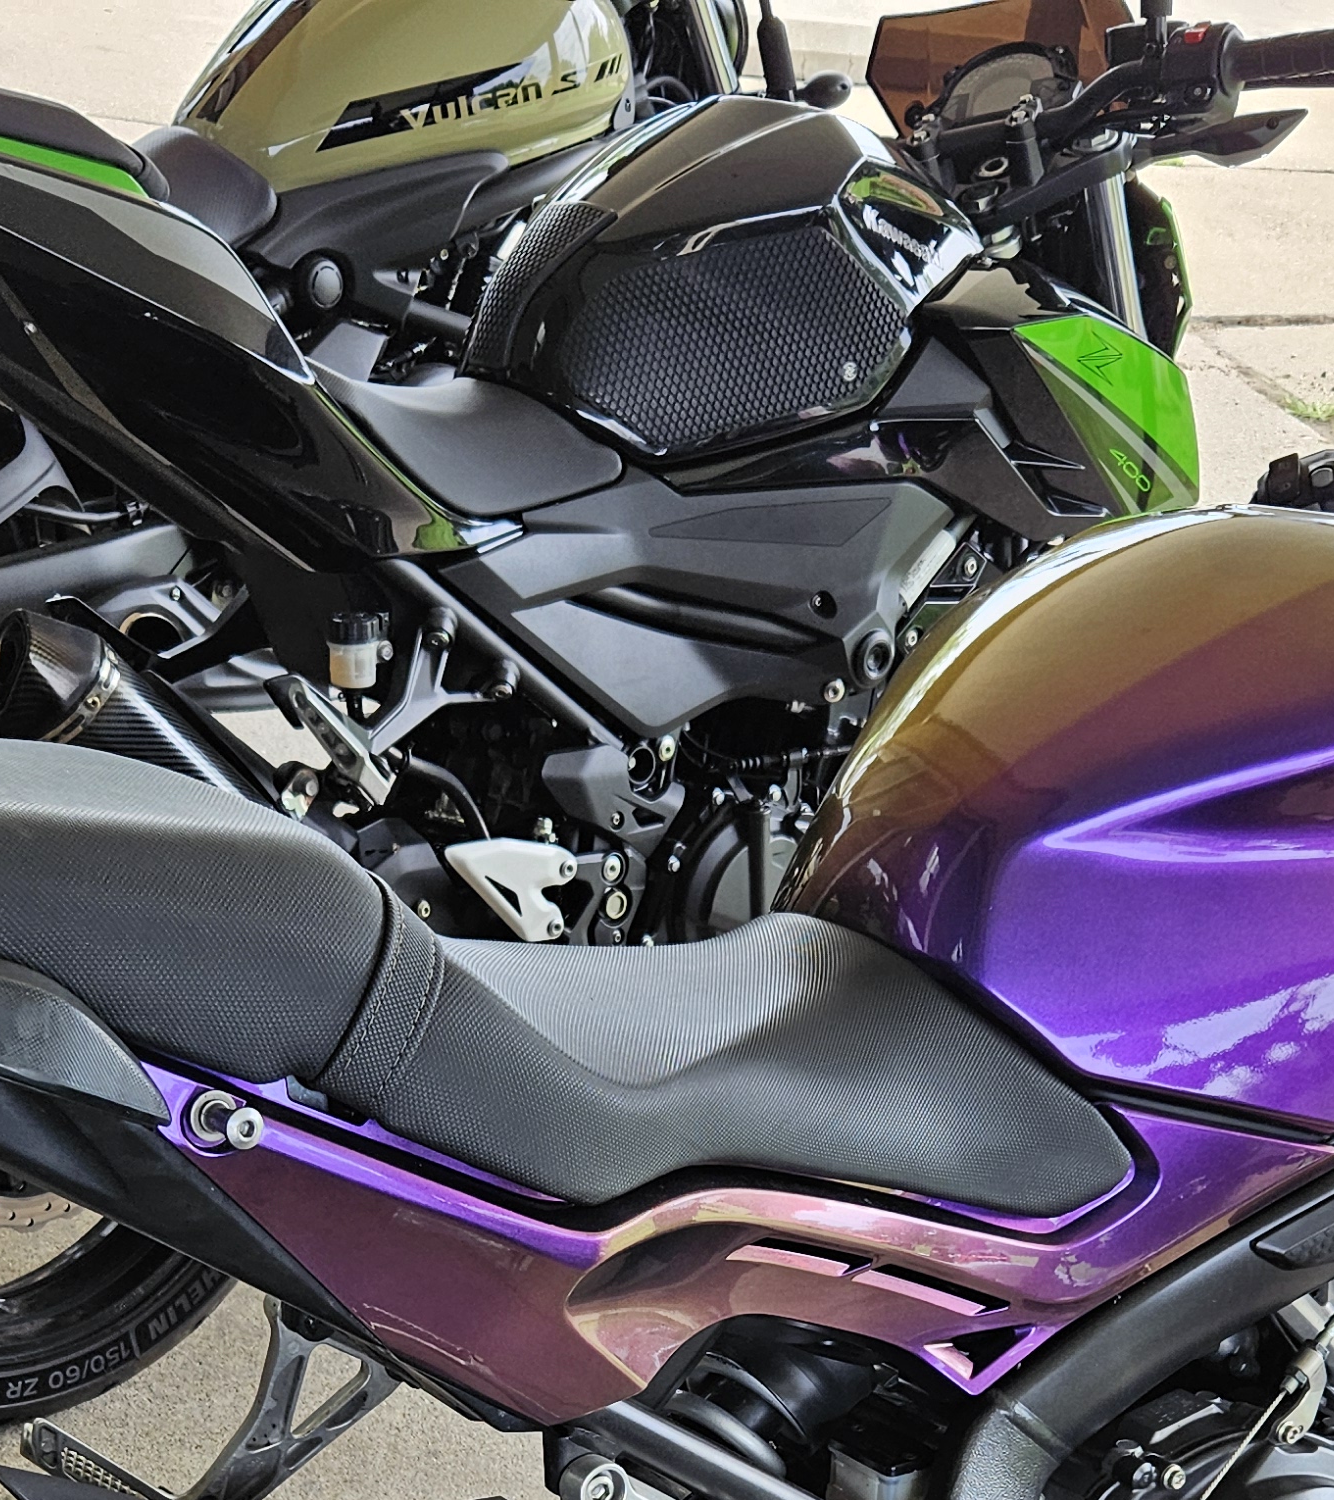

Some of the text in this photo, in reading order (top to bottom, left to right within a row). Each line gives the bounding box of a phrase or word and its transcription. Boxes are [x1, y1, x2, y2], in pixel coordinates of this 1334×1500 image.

[399, 70, 580, 131] Vulcan S
[1109, 448, 1151, 492] 400
[147, 1269, 229, 1342] HELIN
[6, 1377, 38, 1399] ZR
[49, 1338, 133, 1390] 150/60
